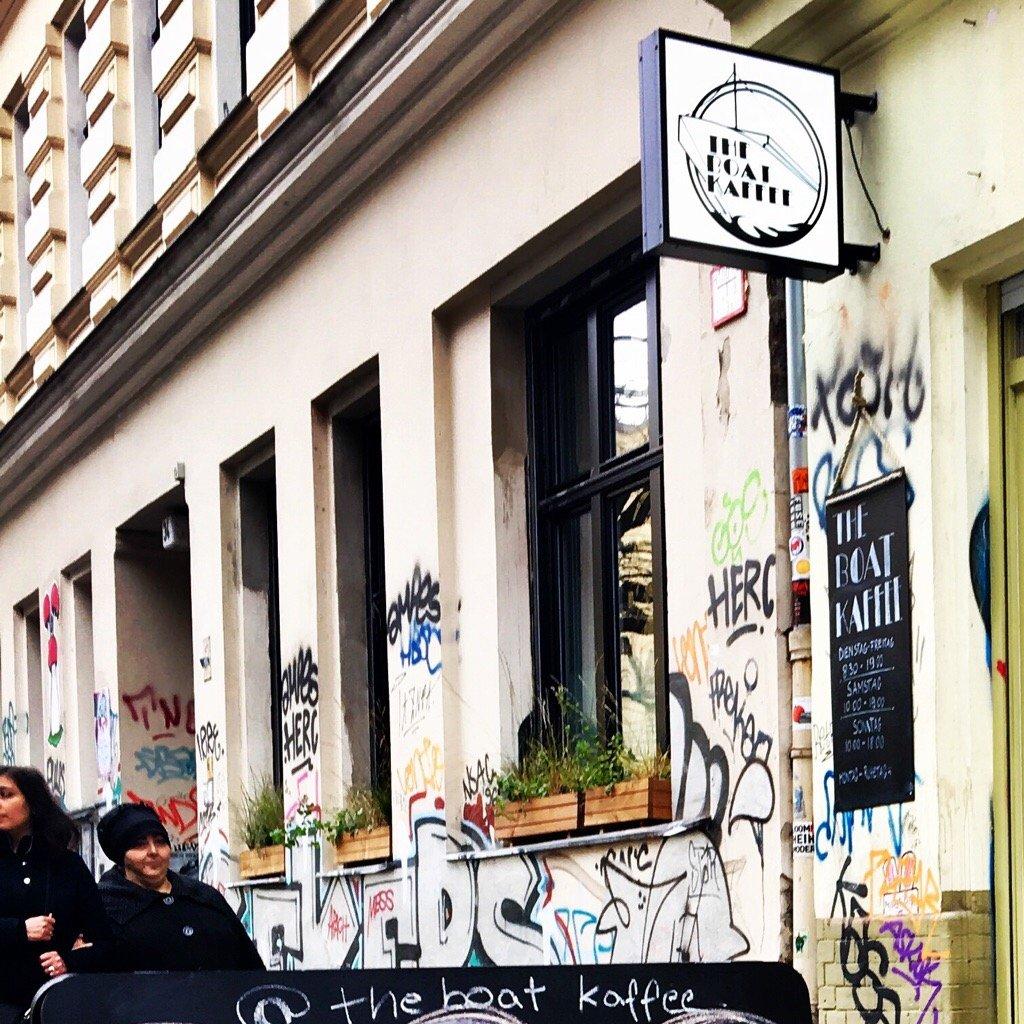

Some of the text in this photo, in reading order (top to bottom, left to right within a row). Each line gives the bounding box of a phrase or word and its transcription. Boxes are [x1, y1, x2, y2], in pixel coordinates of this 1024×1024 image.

[708, 134, 749, 159] THE
[706, 154, 770, 183] BOAT
[707, 174, 790, 207] KAFFEE
[833, 503, 868, 545] THE
[835, 532, 895, 589] BOAT
[835, 575, 903, 638] KAFFEE
[441, 977, 546, 1011] boat
